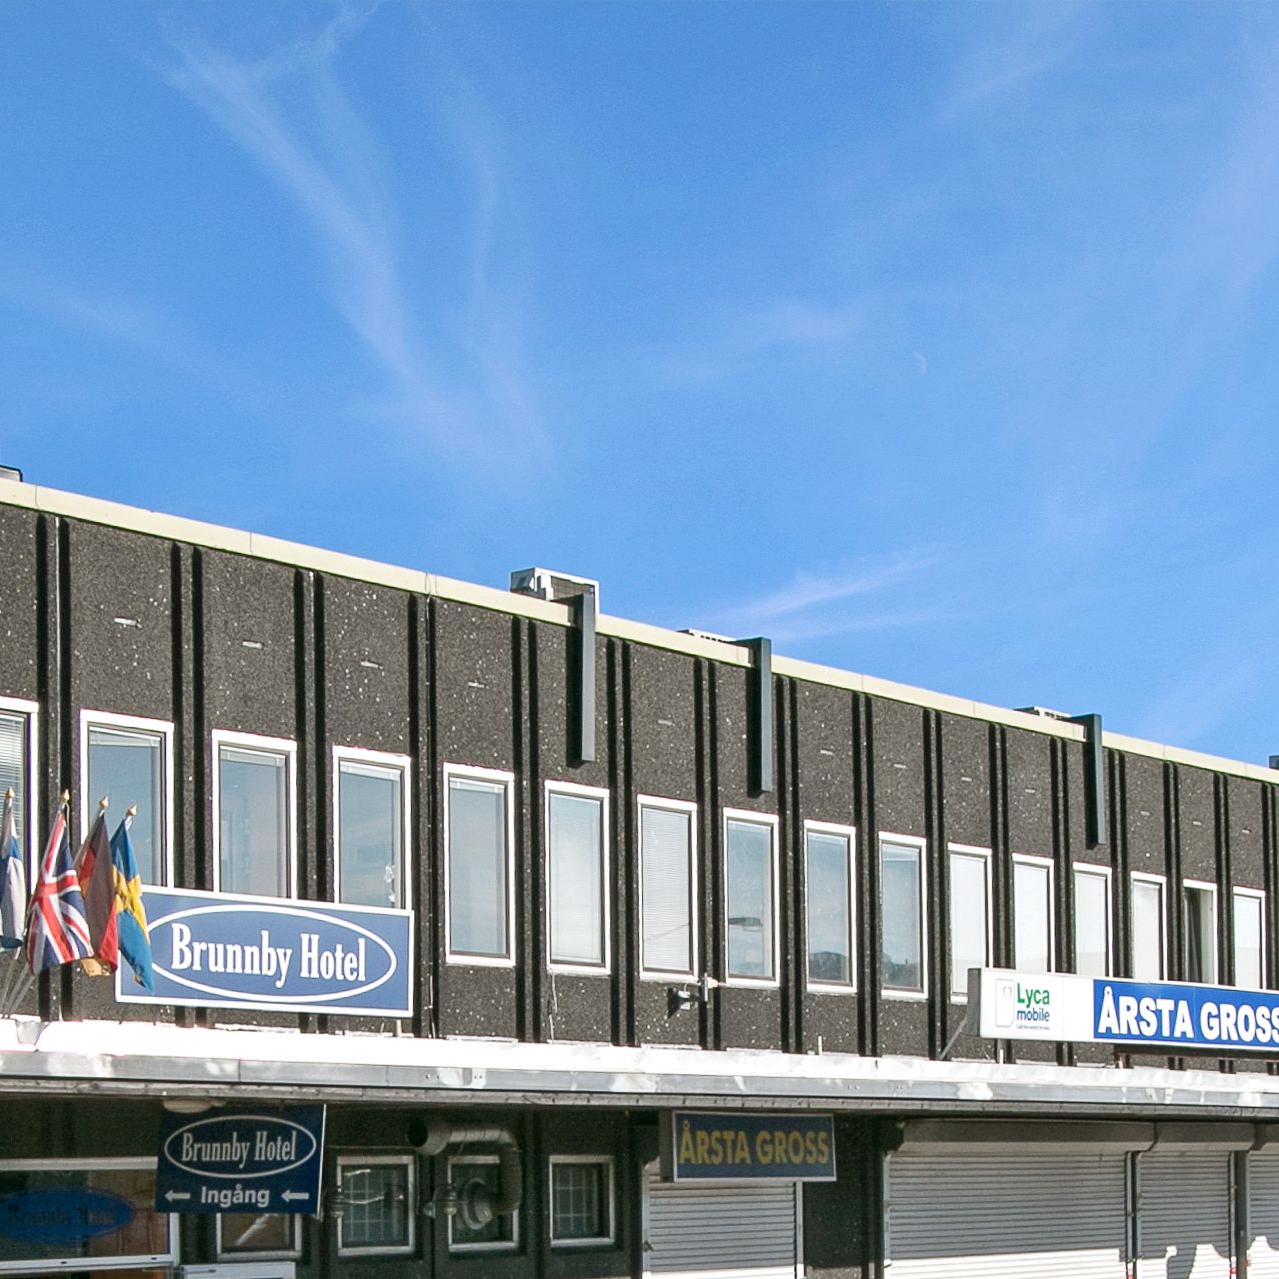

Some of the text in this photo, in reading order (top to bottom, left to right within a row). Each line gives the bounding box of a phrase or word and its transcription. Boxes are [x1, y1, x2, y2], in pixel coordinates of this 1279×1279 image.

[171, 923, 366, 988] Brunnby Hotel
[1016, 982, 1050, 1008] Lyca
[1016, 1007, 1050, 1022] mobile
[1098, 986, 1194, 1039] ÅRSTA
[181, 1130, 297, 1169] Brunnby Hotel
[679, 1119, 830, 1165] ÅRSTA GROSS
[200, 1184, 270, 1208] Ingång
